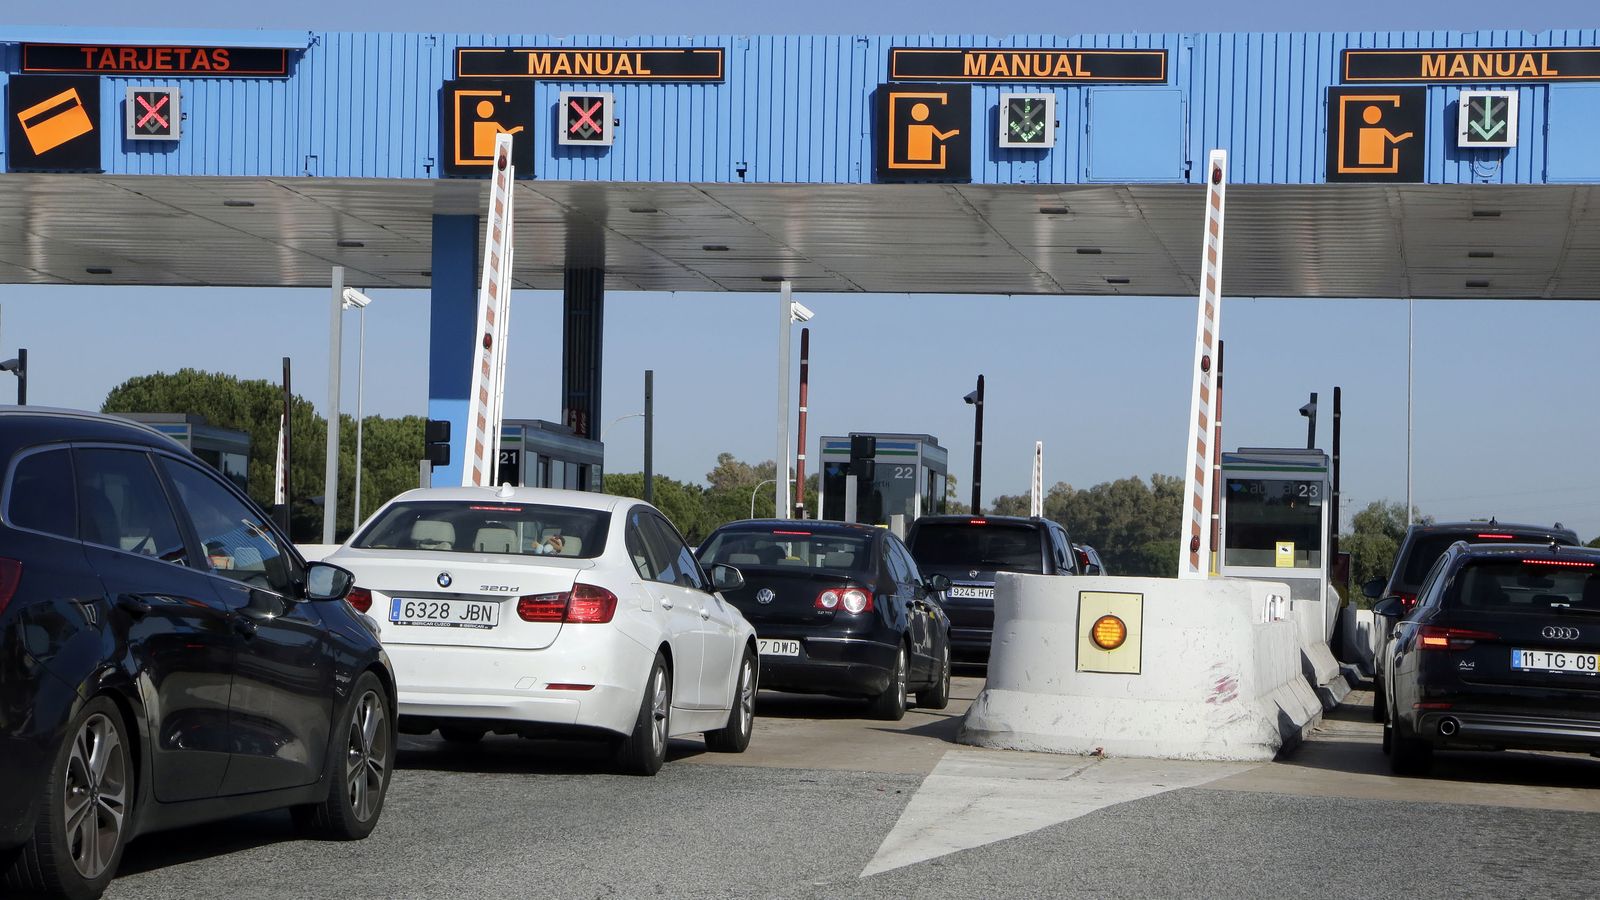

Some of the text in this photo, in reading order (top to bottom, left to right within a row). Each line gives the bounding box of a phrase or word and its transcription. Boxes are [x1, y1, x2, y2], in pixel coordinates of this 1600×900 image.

[81, 47, 230, 71] TARJETAS
[527, 52, 651, 76] MANUAL
[963, 53, 1092, 78] MANUAL
[1421, 53, 1559, 78] MANUAL
[499, 451, 517, 465] 21
[894, 466, 914, 479] 22
[1298, 484, 1319, 498] 23
[953, 588, 976, 597] 9245
[404, 602, 493, 622] 6328 JBN
[773, 642, 797, 654] DWD
